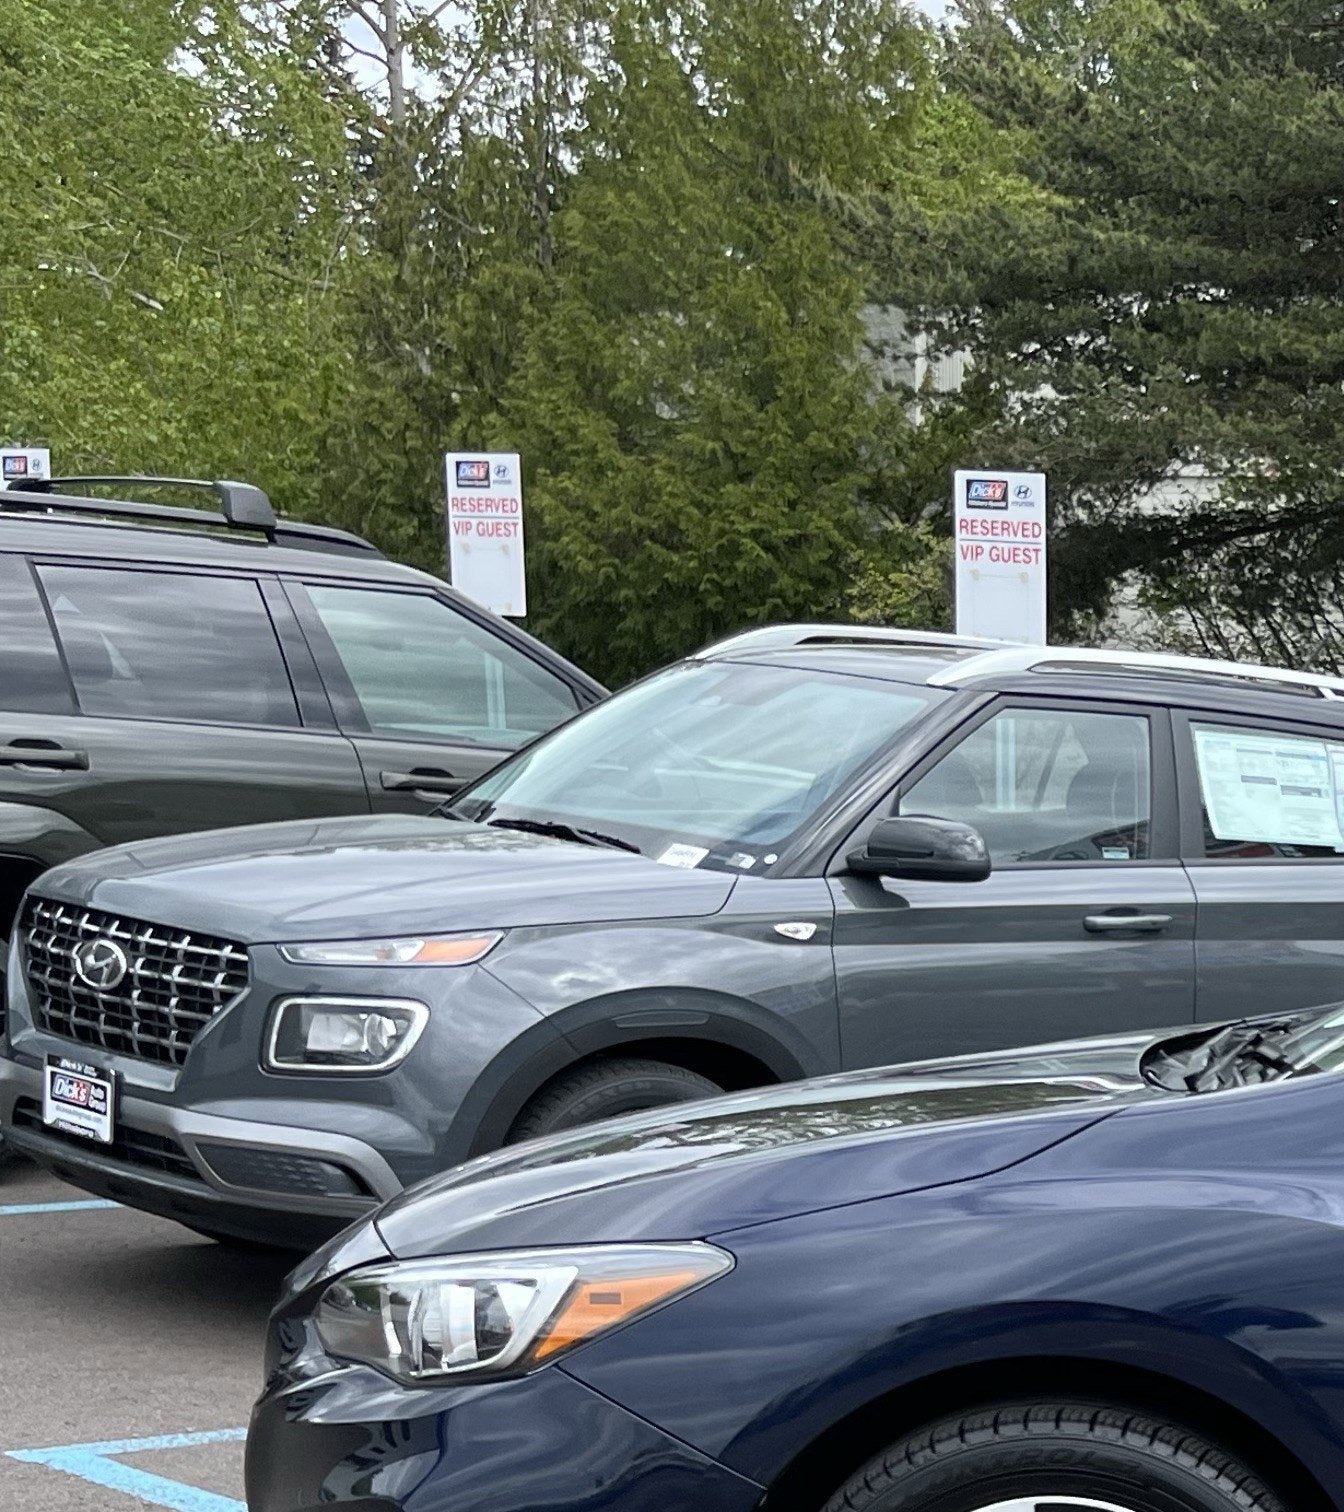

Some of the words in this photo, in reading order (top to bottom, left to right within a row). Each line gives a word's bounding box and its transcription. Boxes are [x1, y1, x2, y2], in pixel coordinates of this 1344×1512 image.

[451, 496, 519, 515] RESERVED
[452, 520, 472, 537] VIP
[476, 521, 519, 538] GUEST
[959, 518, 1042, 539] RESERVED
[960, 543, 984, 561] VIP
[989, 545, 1042, 564] GUEST
